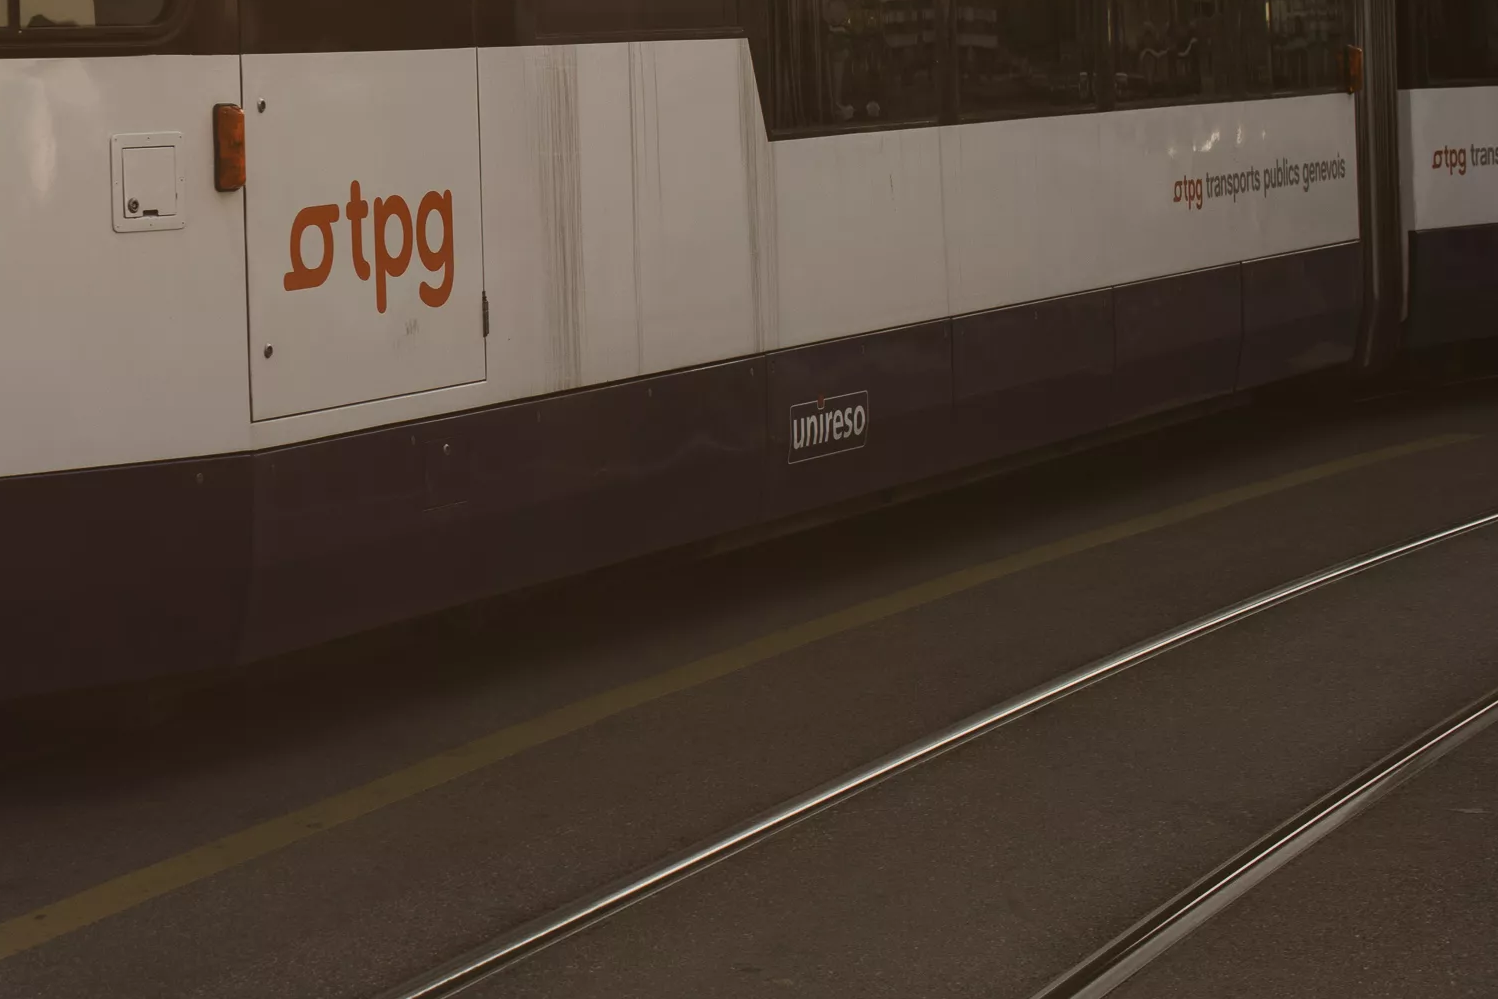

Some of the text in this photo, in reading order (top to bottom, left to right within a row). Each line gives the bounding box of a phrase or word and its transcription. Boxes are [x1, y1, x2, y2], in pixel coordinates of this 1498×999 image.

[1205, 165, 1261, 203] transports
[1263, 157, 1300, 198] publics
[1302, 152, 1346, 193] genevois
[793, 404, 866, 450] unireso
